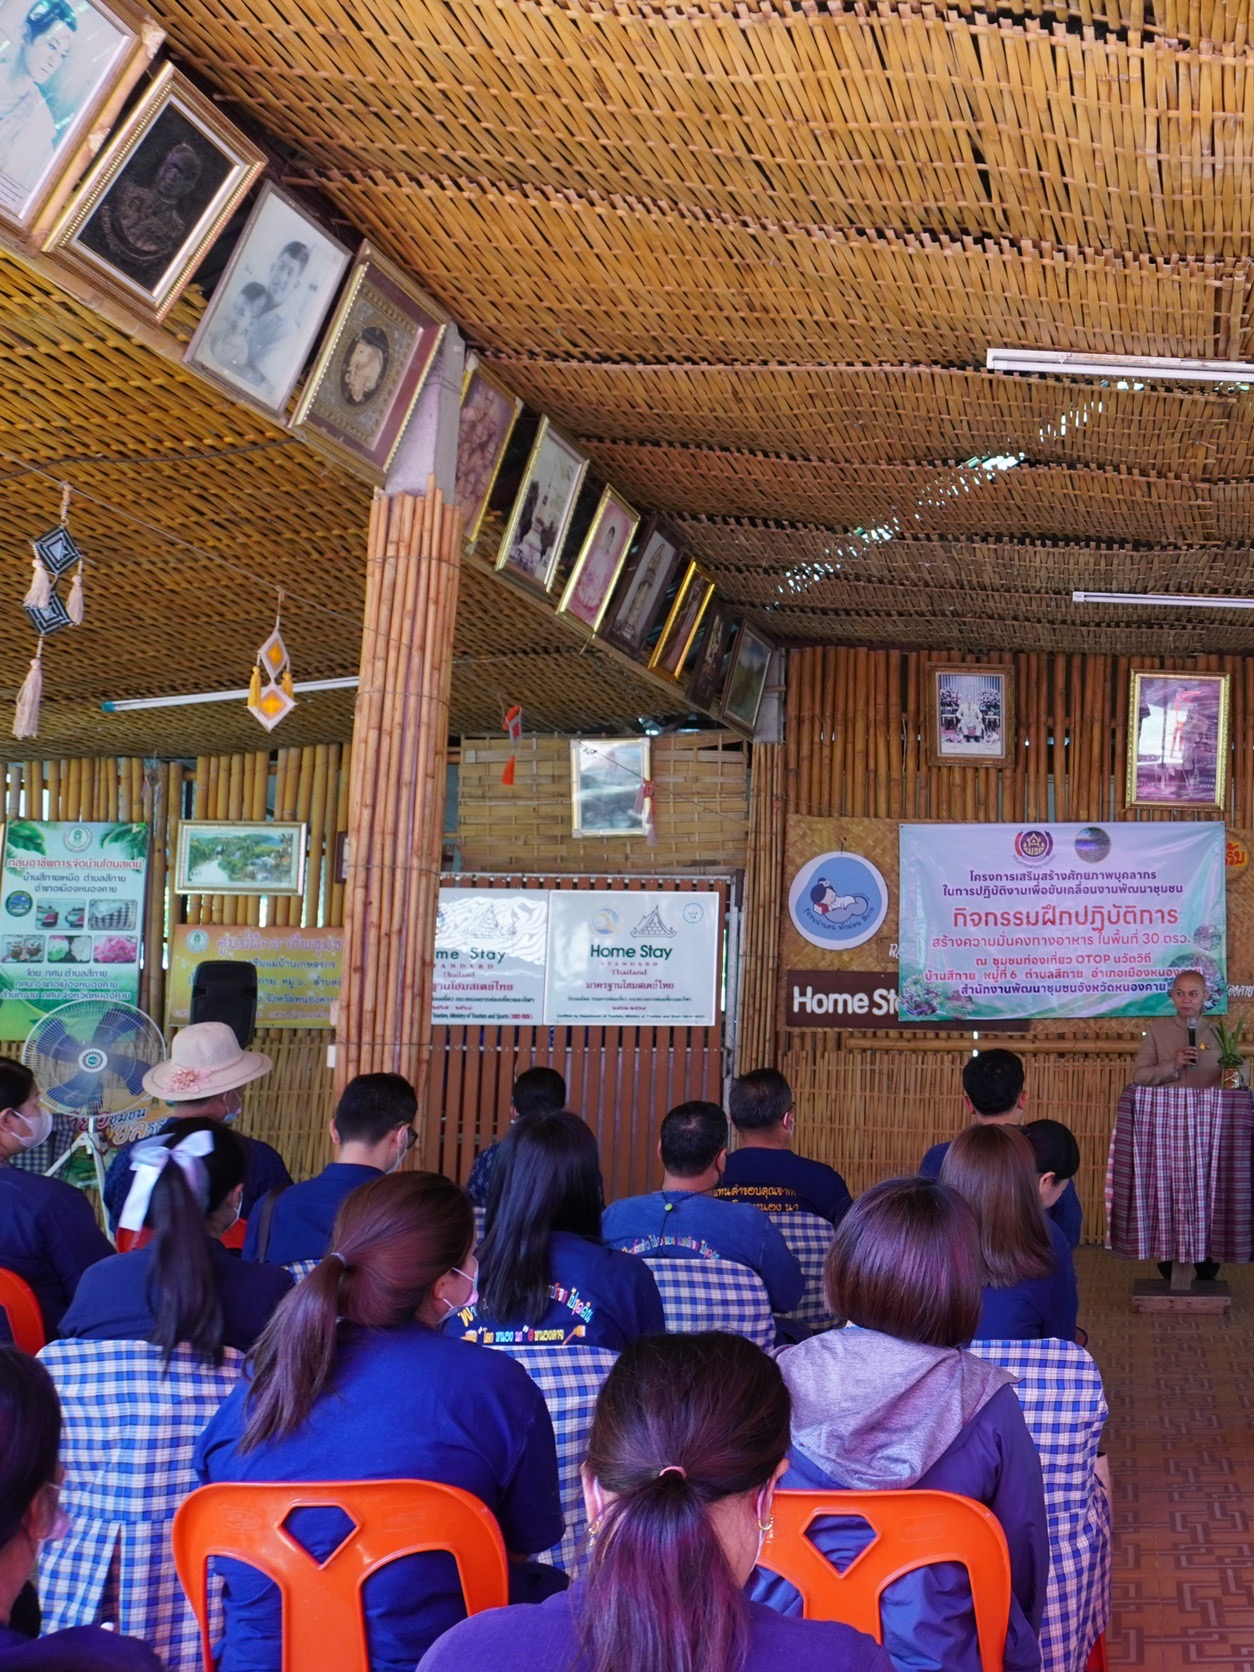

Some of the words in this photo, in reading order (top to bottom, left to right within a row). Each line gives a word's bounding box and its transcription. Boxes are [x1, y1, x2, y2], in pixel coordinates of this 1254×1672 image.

[83, 873, 127, 882] ตำบลสีกาย
[970, 870, 1157, 883] โครงการเสริมสร้างศักยภาพบุคลากร
[35, 884, 117, 893] อำเภอเมืองหนองคาย
[943, 881, 1183, 898] ในการปฏิบัติงานเพื่อขับเคลื่อนงานพัฒนาชุมชน
[953, 904, 1178, 932] กิจกรรมฝึกปฏิบัติการ
[217, 929, 343, 956] ศูนย์ฝึกอาชีพชุมช
[932, 931, 1093, 948] สร้างความมั่นคงทางอาหาร
[1098, 929, 1138, 946] ในพื้นที่
[1142, 933, 1160, 944] 30
[1163, 933, 1191, 944] ตรว.
[435, 950, 459, 960] me
[469, 947, 506, 964] Stay
[590, 944, 635, 958] Home
[640, 944, 673, 960] Stay
[976, 957, 987, 966] ณ
[993, 951, 1072, 969] ชุมชนท่องเที่ยว
[1076, 954, 1111, 965] OTOP
[1114, 952, 1151, 964] นวัตวิถี
[611, 968, 647, 976] Thailand
[925, 970, 976, 981] บ้านสีกาย
[984, 967, 1007, 984] หมู่ที่
[1010, 970, 1018, 979] 6
[1025, 969, 1083, 979] ตำบลสีกาย
[960, 981, 1166, 996] สำนักงานพัฒนาชุมชนจังหวัดหนองคาย
[1227, 985, 1254, 998] องคาย
[793, 985, 869, 1014] Home
[872, 988, 899, 1016] St
